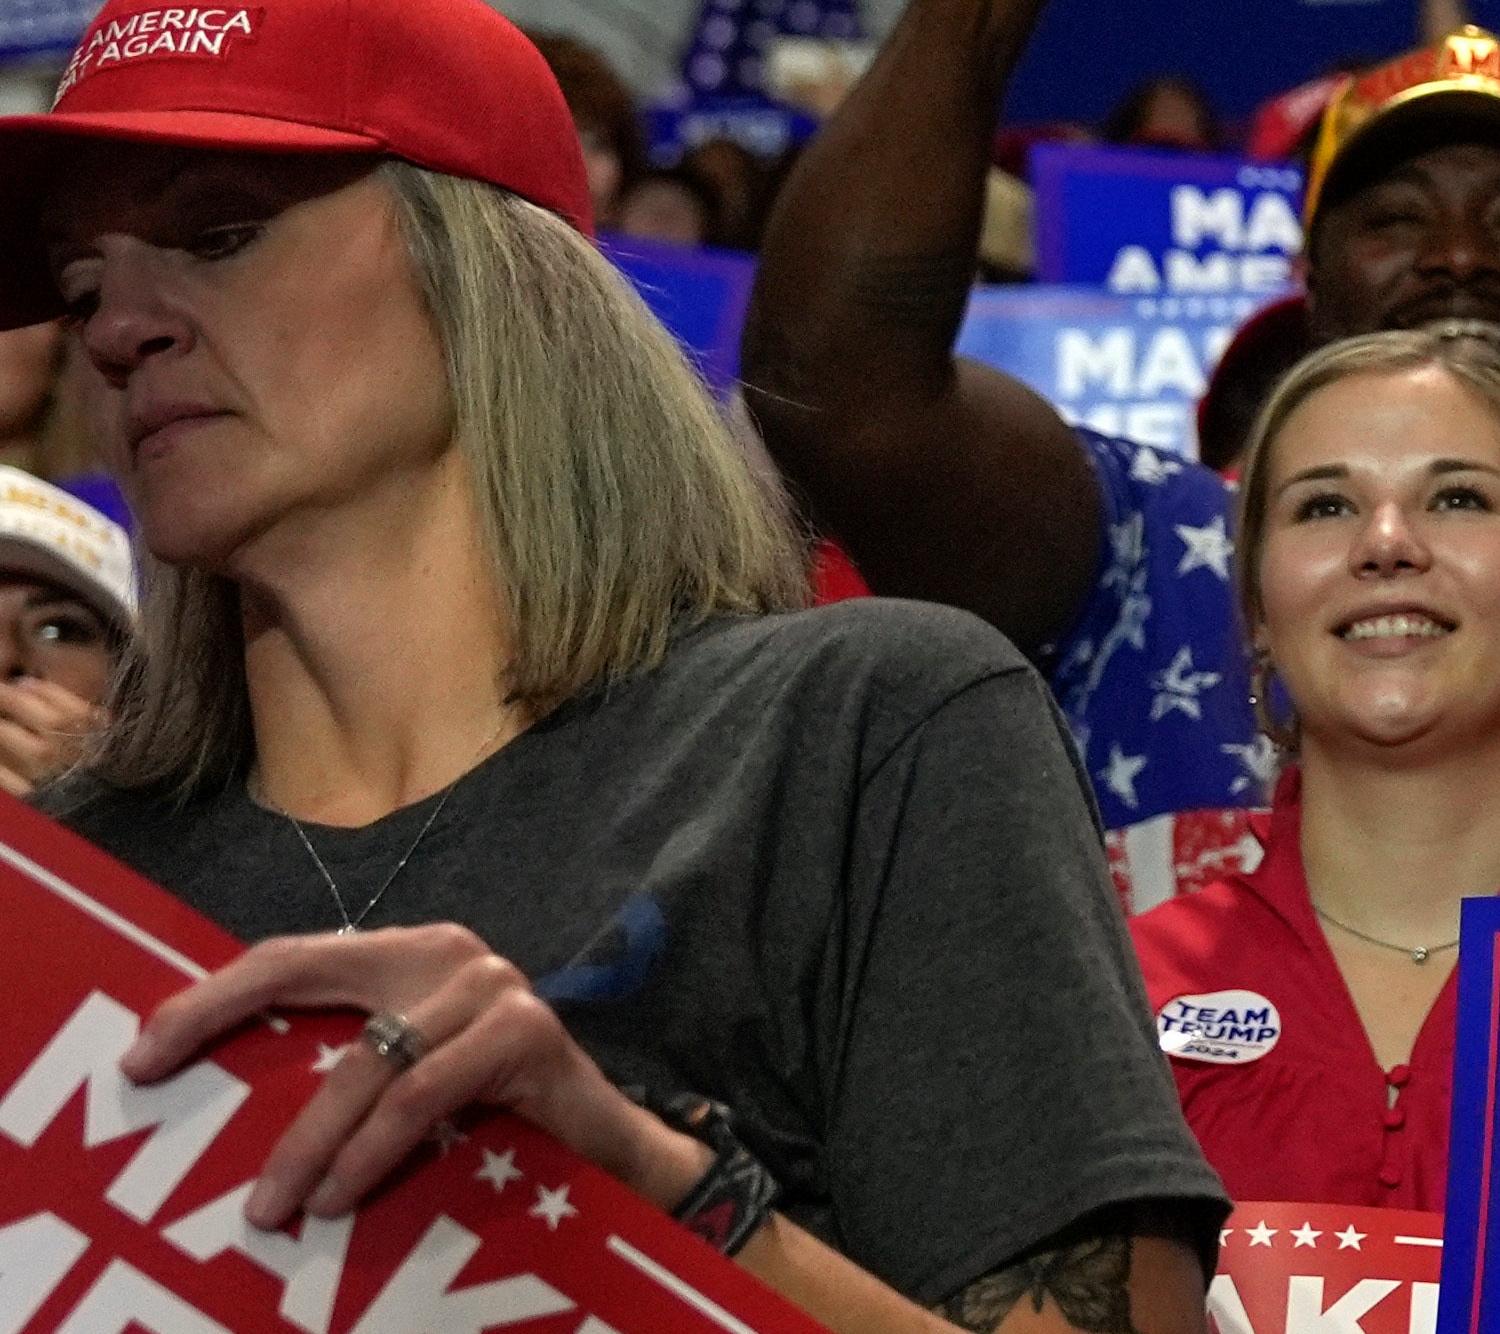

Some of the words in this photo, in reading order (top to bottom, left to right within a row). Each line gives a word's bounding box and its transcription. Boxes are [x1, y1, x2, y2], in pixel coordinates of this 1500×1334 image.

[87, 8, 251, 54] AMERICA
[97, 31, 225, 67] AGAIN
[1171, 186, 1304, 251] MA
[1178, 1000, 1269, 1025] TEAM
